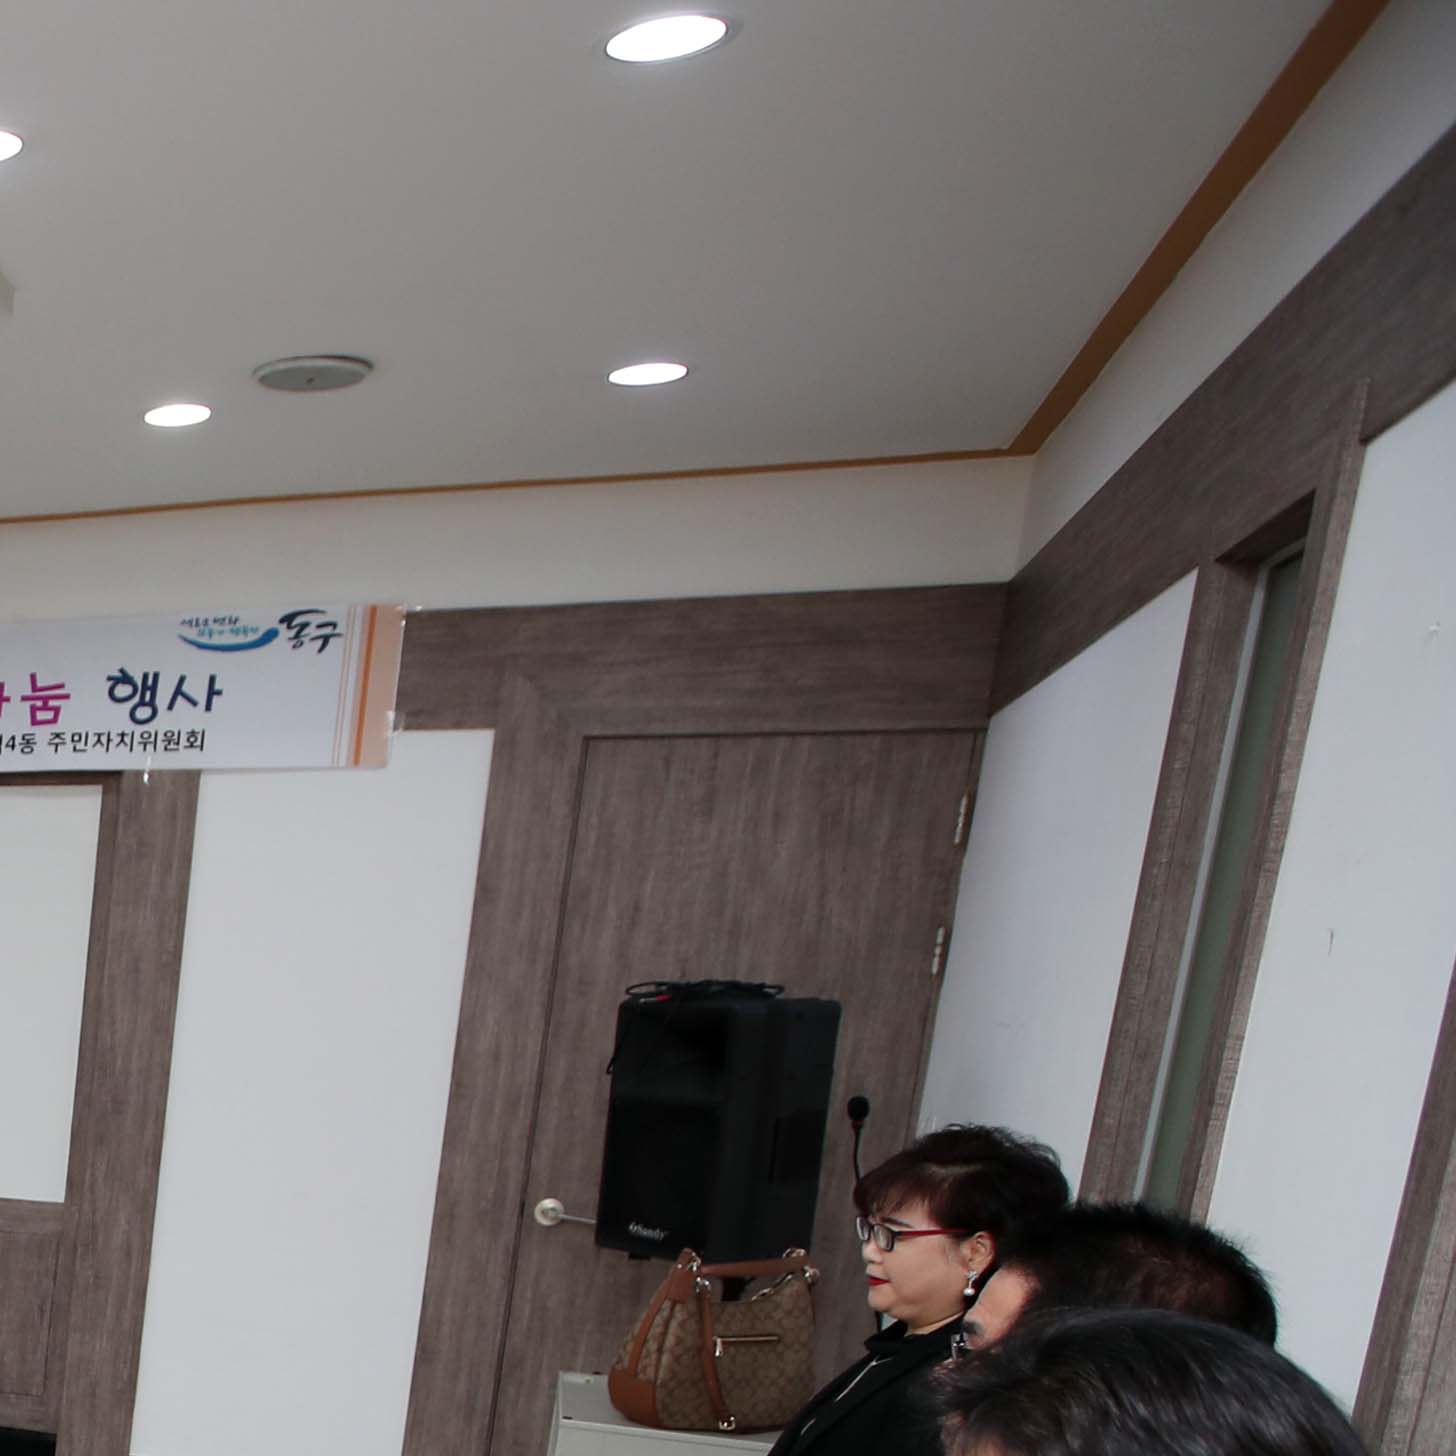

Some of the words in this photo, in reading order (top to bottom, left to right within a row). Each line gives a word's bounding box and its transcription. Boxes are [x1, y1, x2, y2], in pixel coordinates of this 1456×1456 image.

[278, 608, 344, 654] 동구
[105, 666, 224, 725] 행사
[47, 728, 206, 754] 주민자치위원회
